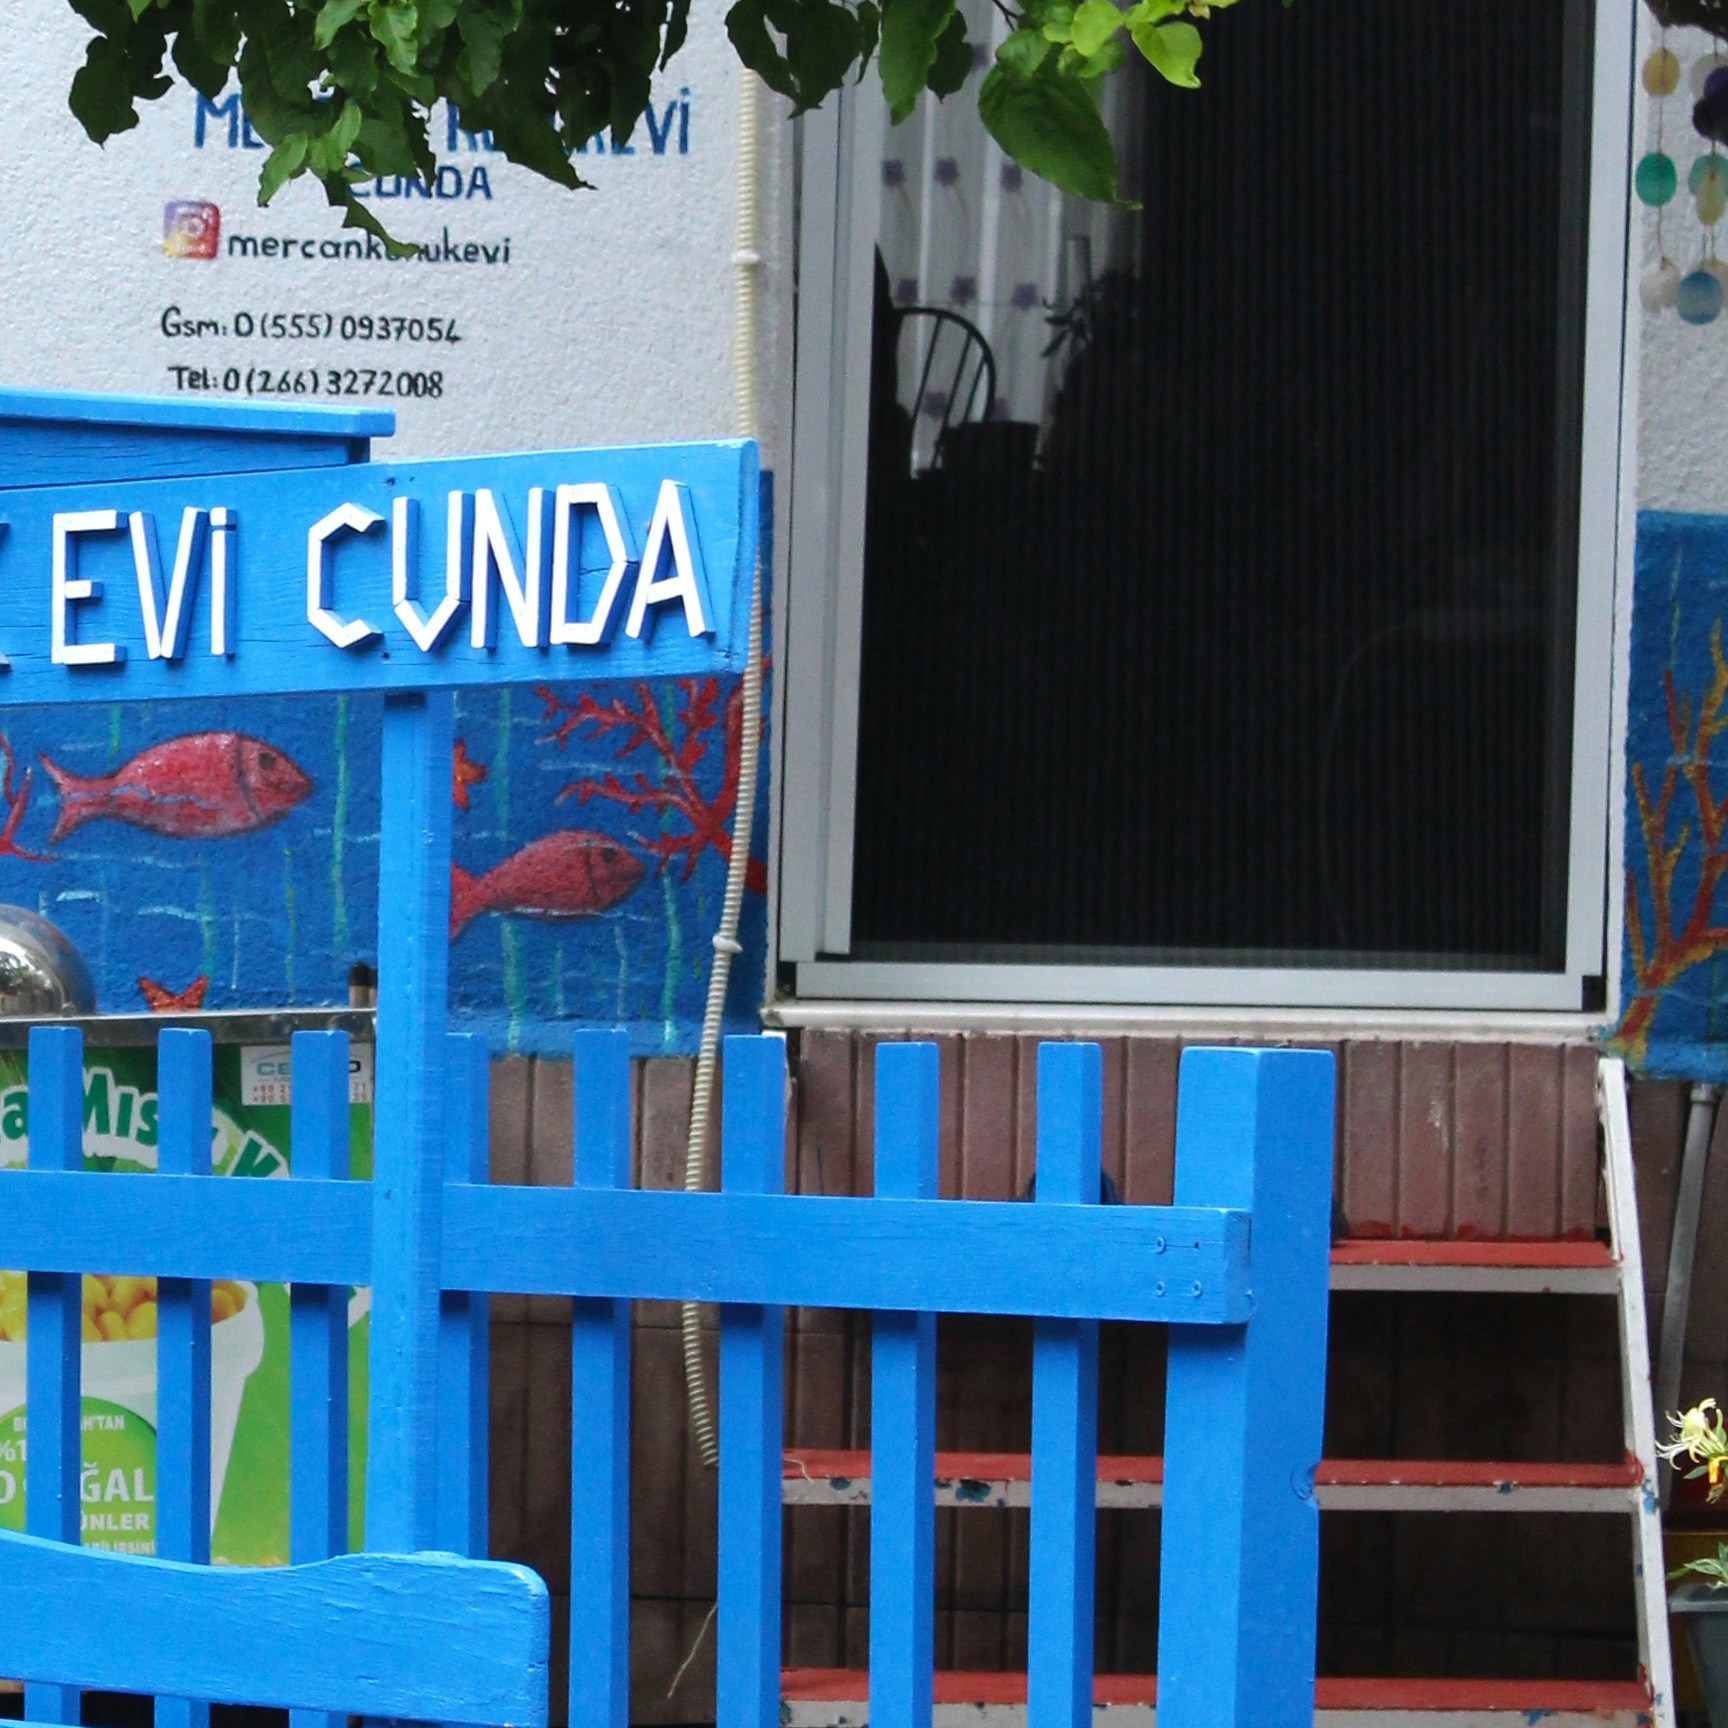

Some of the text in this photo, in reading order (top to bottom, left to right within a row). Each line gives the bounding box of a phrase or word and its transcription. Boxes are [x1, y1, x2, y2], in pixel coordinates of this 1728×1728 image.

[228, 226, 511, 263] mercankukevi
[162, 306, 227, 338] Gsm:
[340, 315, 462, 345] 0937054
[325, 369, 443, 399] 3272008
[307, 478, 712, 653] CUNDA
